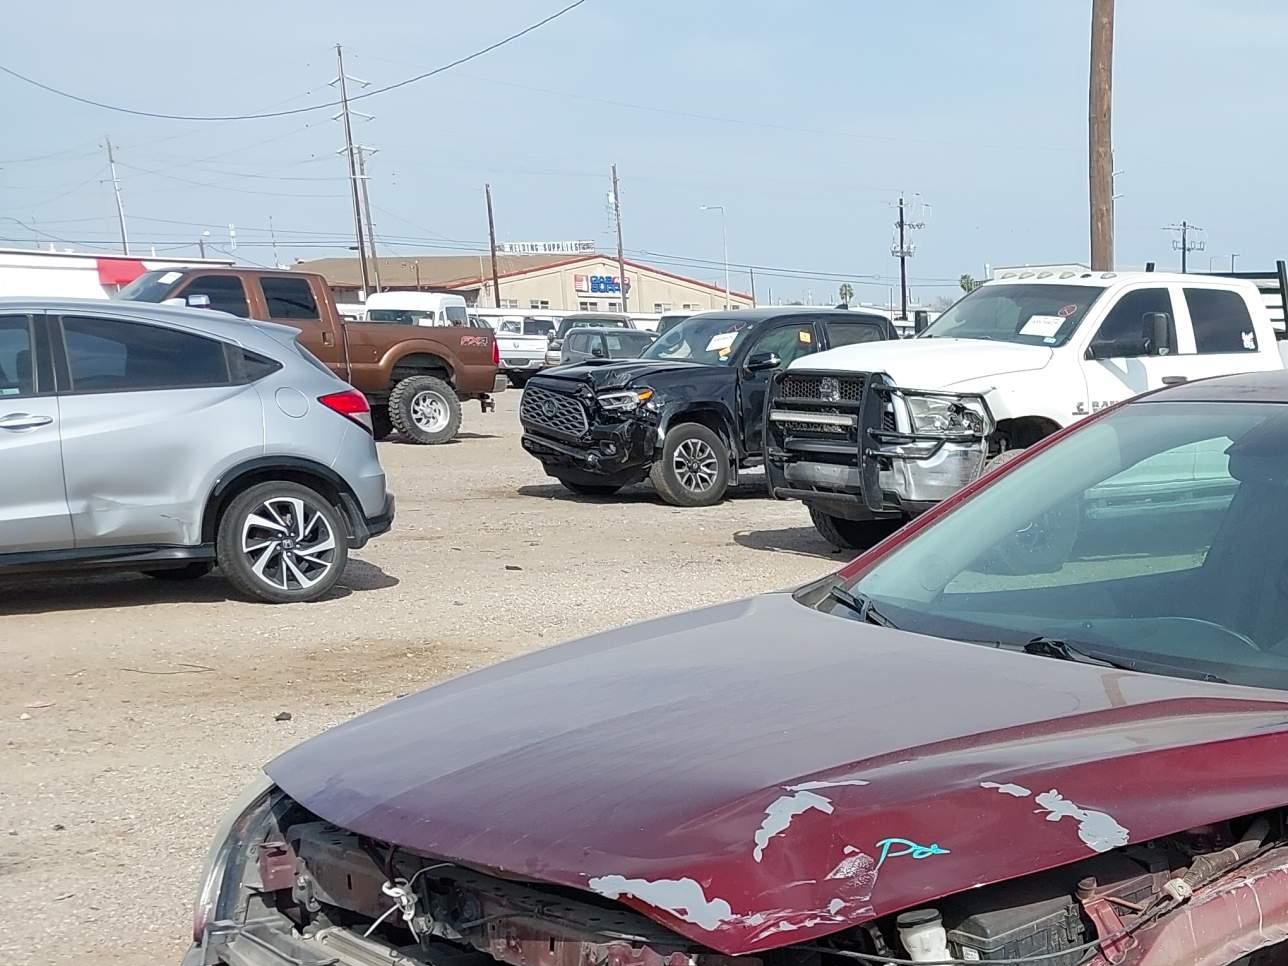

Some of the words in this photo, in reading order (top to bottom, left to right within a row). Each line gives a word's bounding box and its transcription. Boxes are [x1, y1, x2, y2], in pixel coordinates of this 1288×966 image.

[508, 243, 539, 253] WELDING
[543, 242, 579, 252] SUPPLIES
[460, 336, 488, 346] FX4
